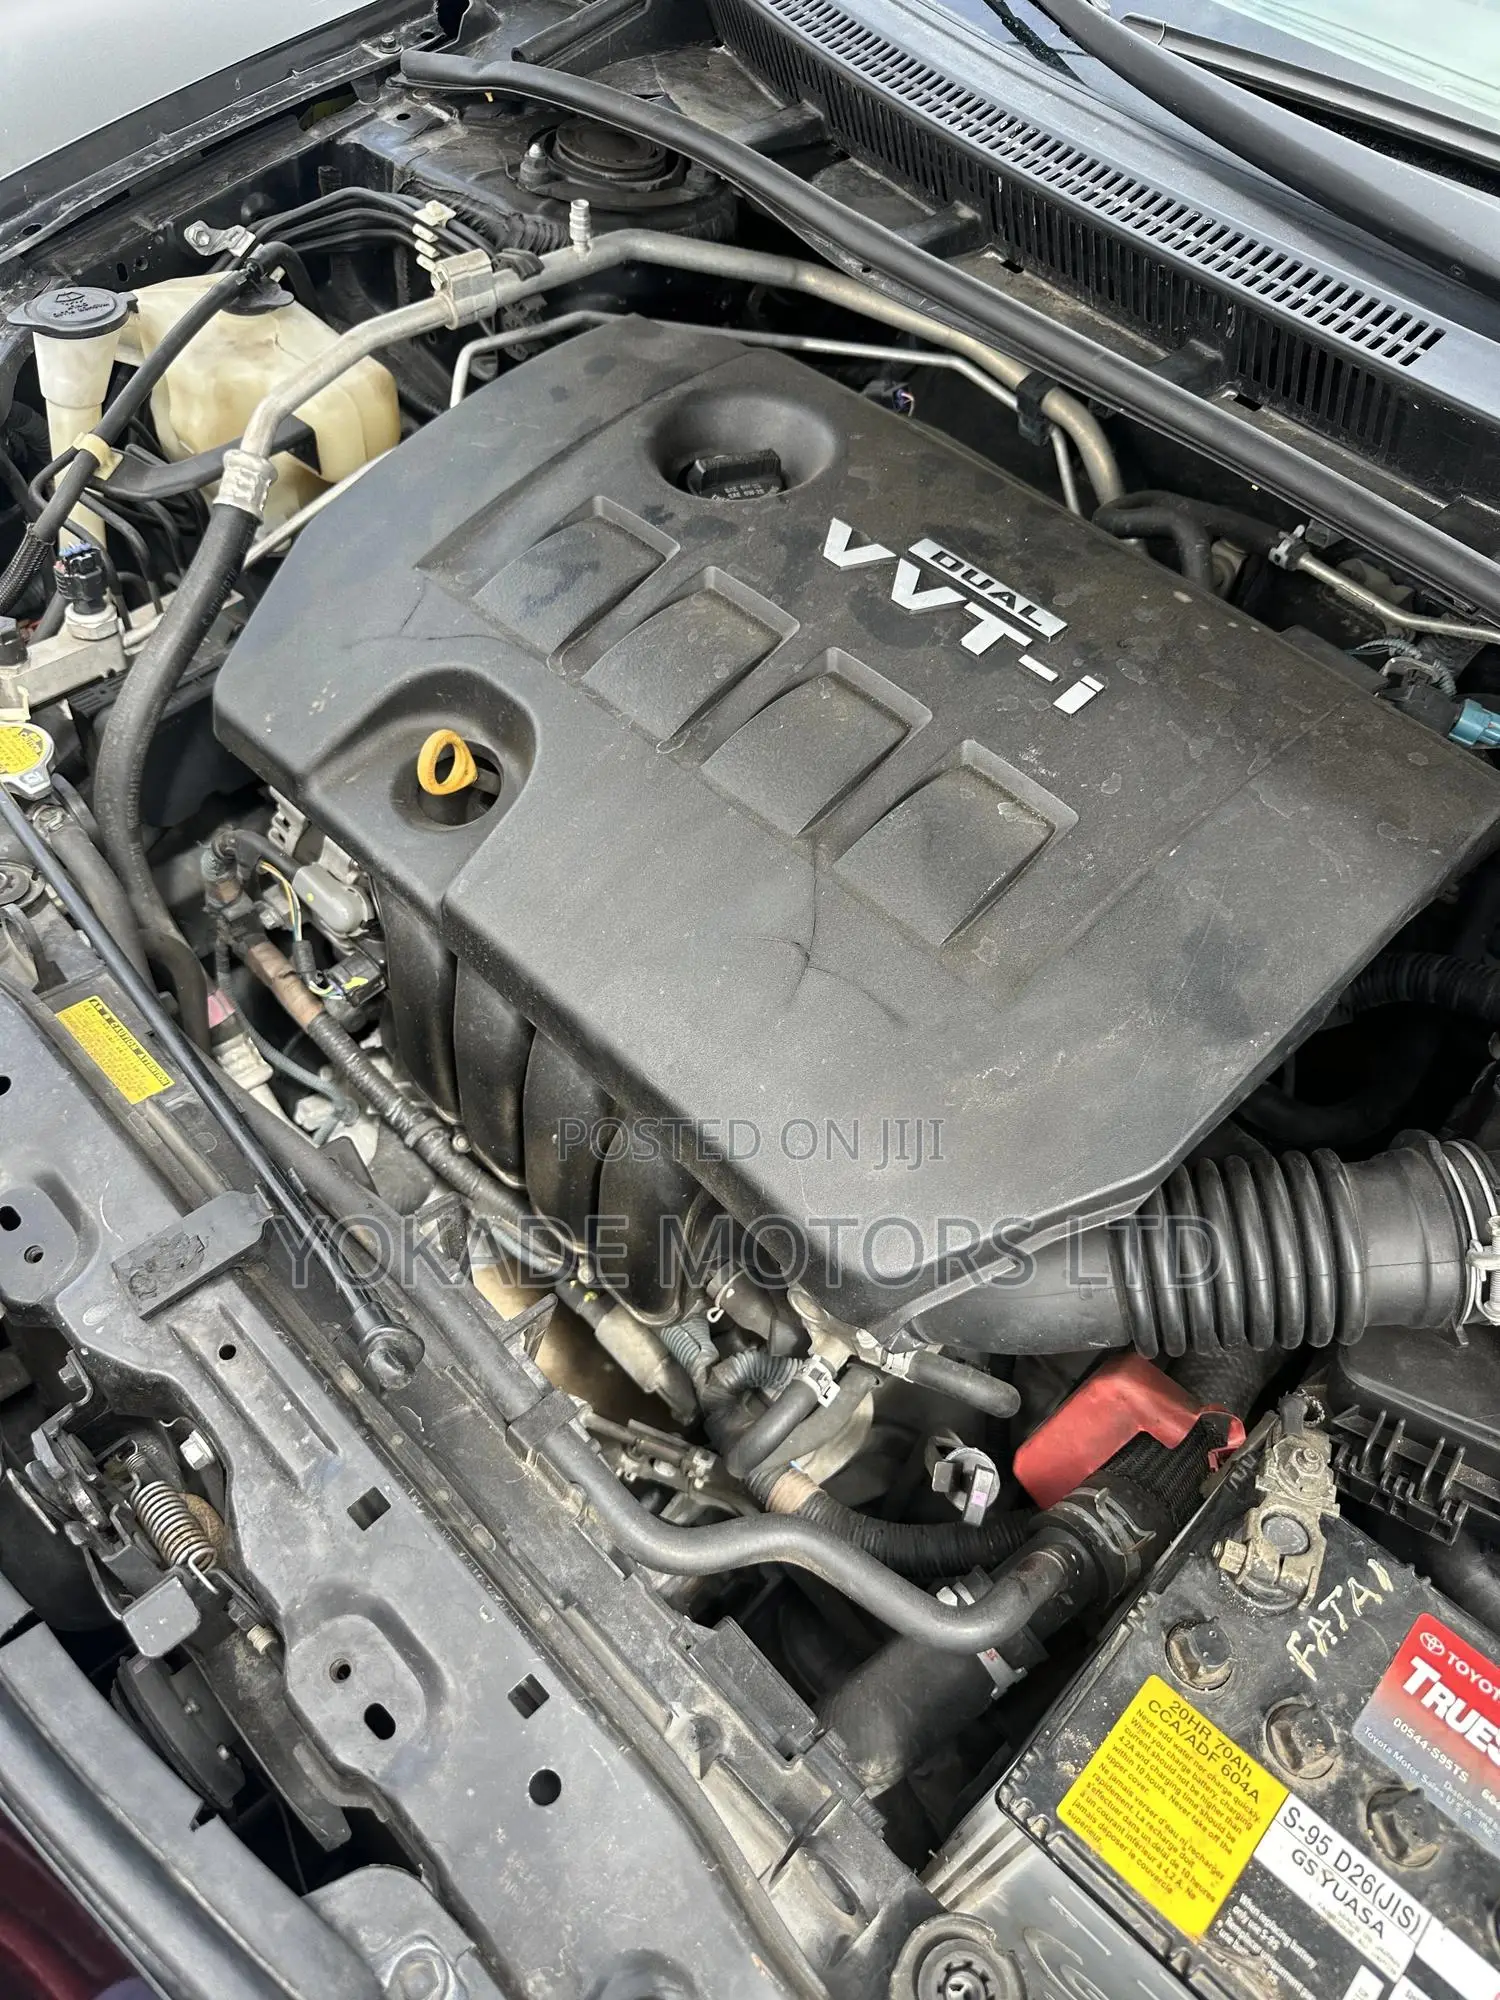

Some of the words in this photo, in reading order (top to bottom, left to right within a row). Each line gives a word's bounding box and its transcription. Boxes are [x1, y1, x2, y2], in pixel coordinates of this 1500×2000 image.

[823, 517, 1105, 715] VVT-i
[930, 550, 1043, 627] DUAL
[109, 1019, 139, 1052] CAUTION
[136, 1050, 170, 1087] ATTENTION
[1105, 1752, 1128, 1774] upper
[1130, 1716, 1151, 1739] When
[1149, 1736, 1166, 1752] you
[1165, 1750, 1191, 1774] charge
[1219, 1797, 1253, 1831] charging
[1135, 1707, 1158, 1730] Never
[1157, 1728, 1173, 1743] add
[1172, 1741, 1194, 1761] water
[1192, 1759, 1207, 1773] nor
[1206, 1772, 1232, 1797] charge
[1147, 1699, 1220, 1762] CCA/ADF
[1220, 1763, 1259, 1804] 604A
[1168, 1700, 1212, 1741] 20HR
[1214, 1737, 1252, 1777] 70Ah
[1364, 1726, 1392, 1753] Toyota
[1392, 1751, 1419, 1776] Motor
[1393, 1717, 1468, 1782] 00544-S95TS
[1085, 1795, 1096, 1808] un
[1095, 1805, 1125, 1835] courant
[1097, 1761, 1110, 1775] Ne
[1107, 1772, 1134, 1797] jamais
[1134, 1795, 1158, 1819] verser
[1111, 1743, 1134, 1766] within
[1135, 1763, 1145, 1775] 10
[1167, 1793, 1191, 1816] Never
[1190, 1814, 1207, 1832] take
[1207, 1831, 1221, 1843] off
[1218, 1839, 1232, 1855] the
[1123, 1726, 1151, 1753] current
[1149, 1750, 1177, 1775] should
[1175, 1772, 1190, 1787] not
[1188, 1783, 1200, 1796] be
[1199, 1793, 1224, 1818] higher
[1224, 1815, 1242, 1835] than
[1134, 1750, 1150, 1765] and
[1149, 1763, 1182, 1796] charging
[1181, 1791, 1199, 1810] time
[1198, 1807, 1226, 1834] should
[1224, 1830, 1236, 1844] be
[1071, 1797, 1097, 1824] jamais
[1135, 1858, 1173, 1894] couvercle
[1121, 1814, 1140, 1834] dans
[1139, 1831, 1151, 1844] un
[1168, 1858, 1179, 1870] de
[1180, 1866, 1191, 1879] 10
[1188, 1875, 1216, 1903] heures
[1134, 1809, 1145, 1823] La
[1144, 1820, 1178, 1853] recharge
[1178, 1851, 1195, 1869] doit
[1283, 1806, 1332, 1855] S-95
[1332, 1849, 1420, 1935] D26(JIS)
[1229, 1905, 1250, 1924] only
[1247, 1919, 1262, 1935] use
[1238, 1892, 1260, 1917] When
[1258, 1912, 1294, 1947] replacing
[1286, 1938, 1317, 1969] battery
[1291, 1848, 1318, 1876] GS
[1320, 1868, 1383, 1938] YUASA
